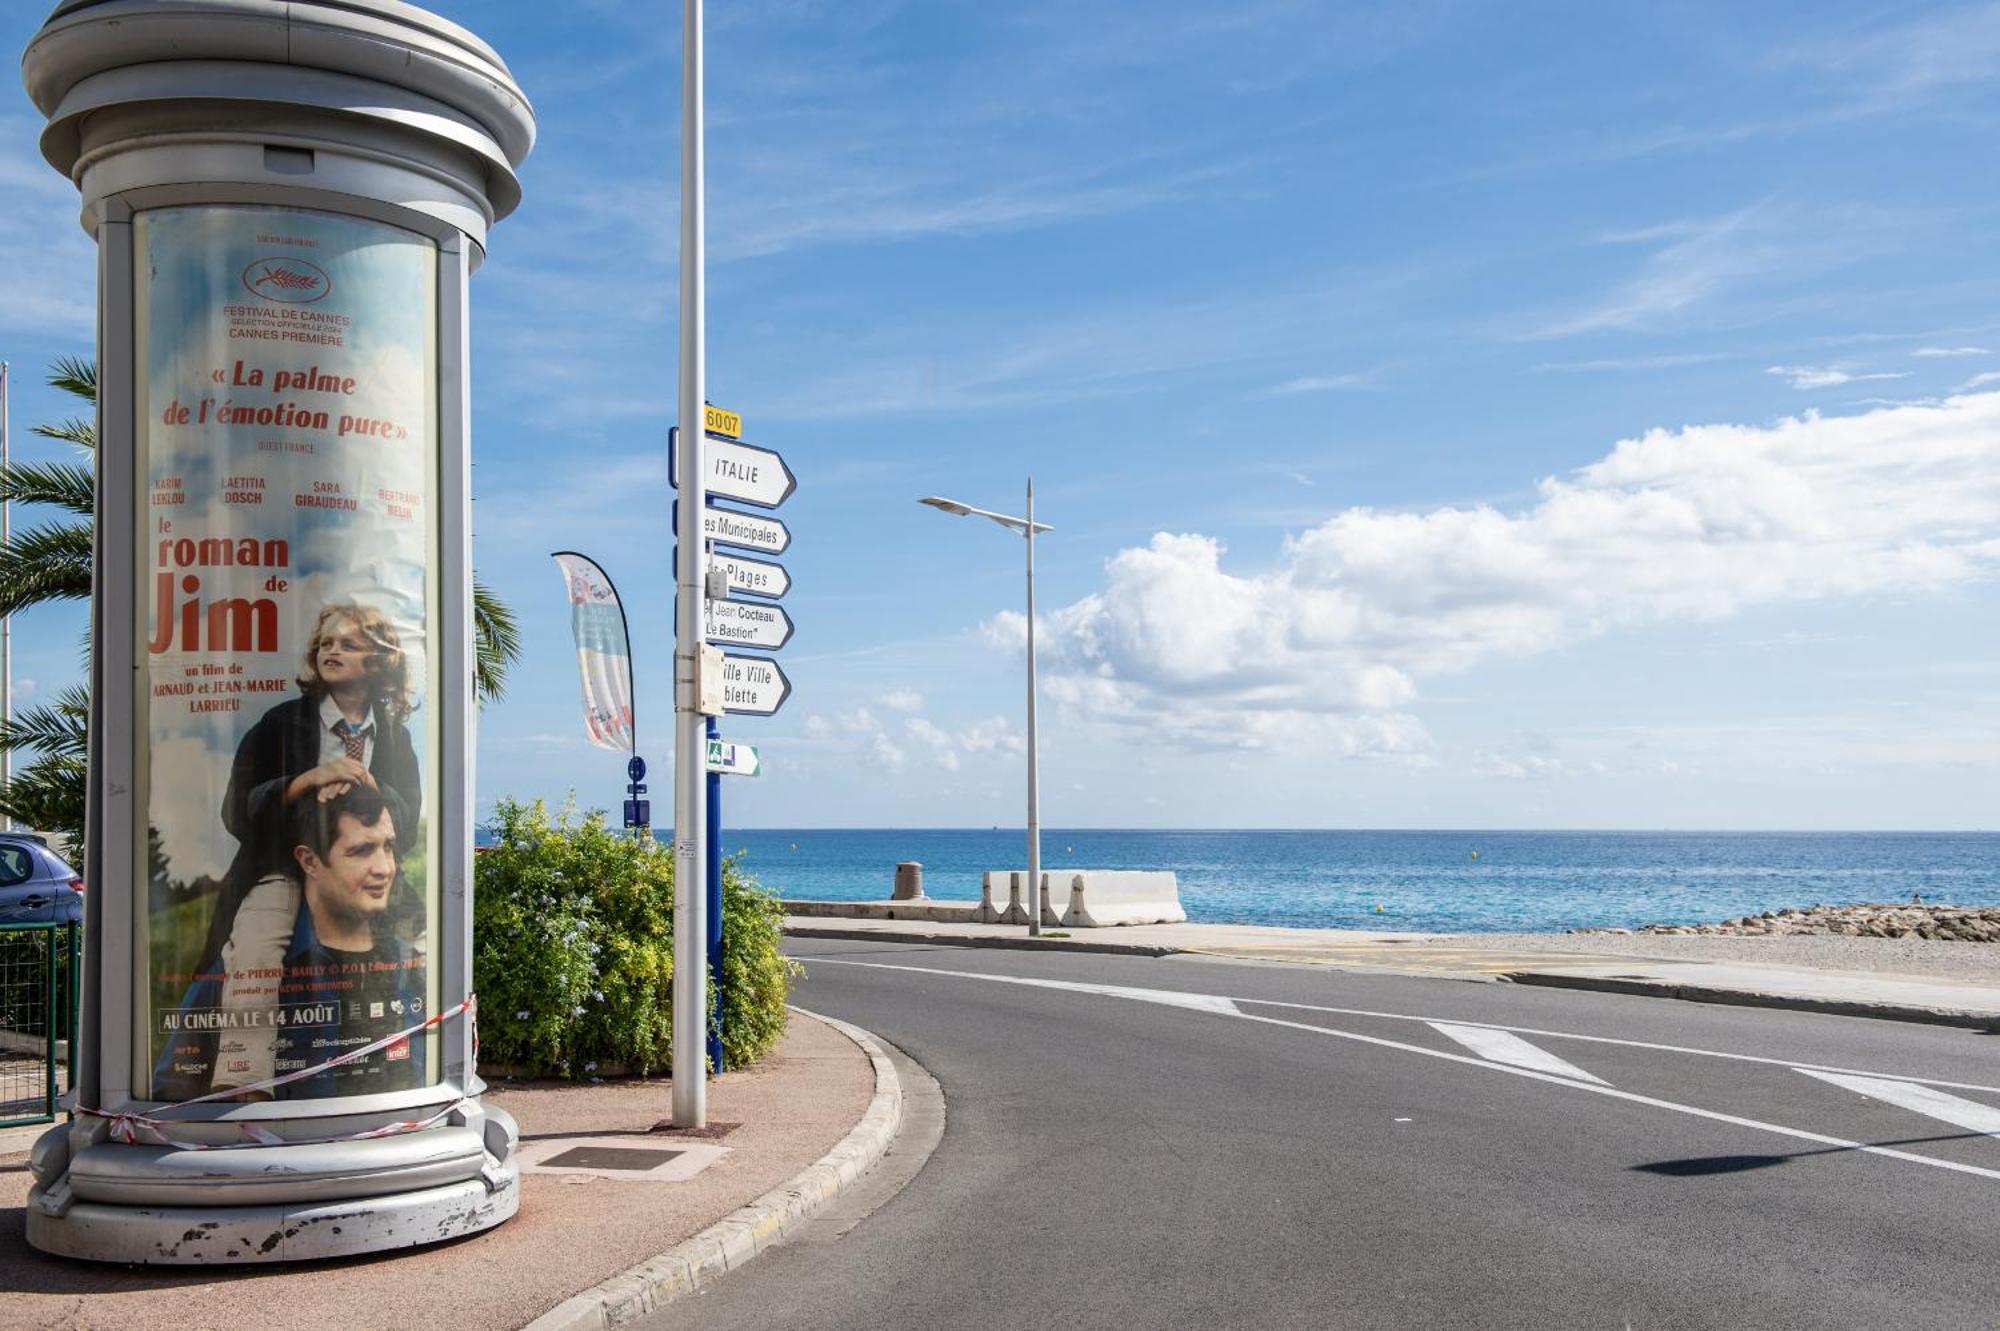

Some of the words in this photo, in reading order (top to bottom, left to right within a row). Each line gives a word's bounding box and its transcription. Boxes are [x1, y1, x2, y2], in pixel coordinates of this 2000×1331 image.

[224, 305, 279, 319] FESTIVAL
[281, 309, 298, 320] DE
[300, 311, 350, 326] CANNES
[229, 328, 279, 340] CANNES
[233, 360, 264, 387] La
[272, 366, 356, 395] palme
[164, 400, 191, 426] de
[706, 410, 739, 433] 6007
[715, 458, 759, 483] ITALIE
[155, 478, 182, 489] KARIM
[221, 477, 266, 489] LAETITIA
[313, 480, 341, 494] SARA
[152, 491, 185, 505] LEKLOU
[225, 492, 263, 505] DOSCH
[295, 495, 358, 513] GIRAUDEAU
[158, 516, 172, 534] le
[705, 518, 716, 532] es
[718, 516, 777, 544] Municipales
[158, 538, 289, 567] roman
[265, 575, 288, 592] de
[148, 572, 278, 654] Jim
[738, 606, 774, 622] Cocteau
[185, 666, 199, 676] un
[202, 663, 224, 676] film
[229, 663, 243, 675] de
[723, 663, 741, 681] ille
[747, 666, 772, 684] Ville
[153, 685, 194, 697] ARNAUD
[198, 684, 208, 694] et
[212, 679, 287, 693] JEAN-MARIE
[190, 700, 240, 713] LARRIEU
[163, 1014, 180, 1030] AU
[184, 1009, 238, 1030] CINÉMA
[243, 1012, 259, 1027] LE
[268, 1010, 287, 1025] 14
[293, 1004, 335, 1024] AOÛT
